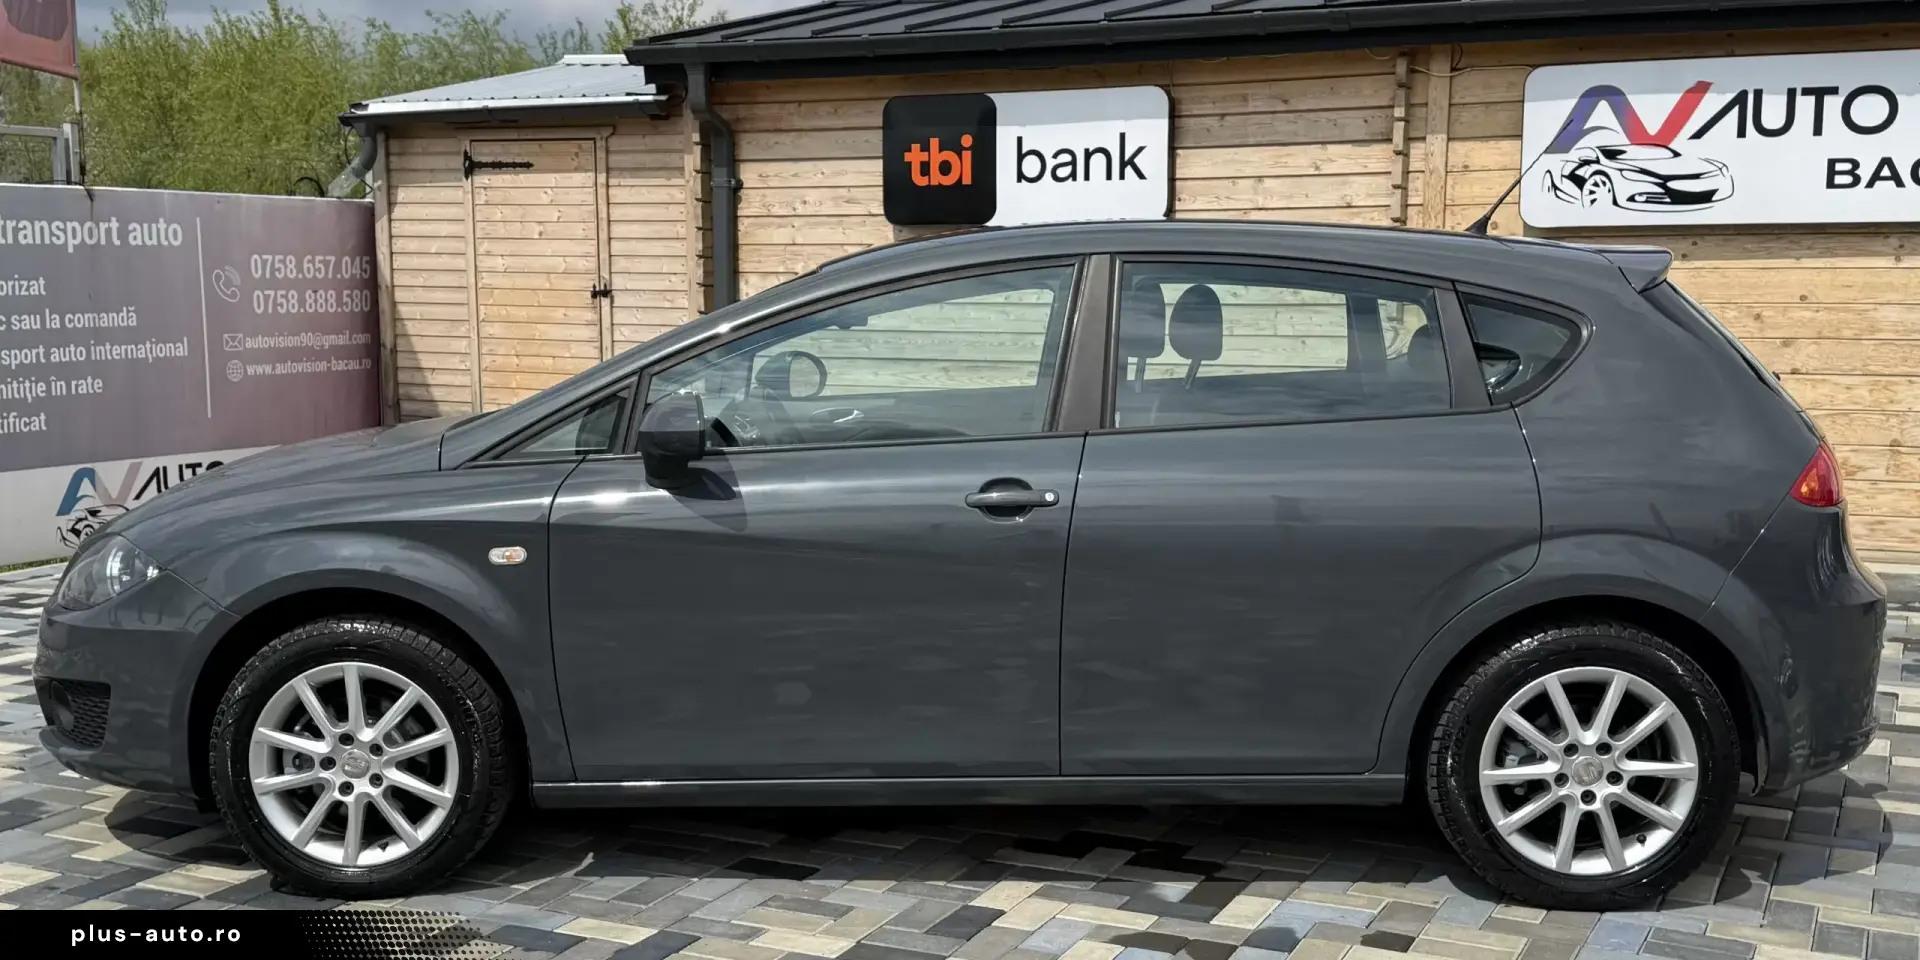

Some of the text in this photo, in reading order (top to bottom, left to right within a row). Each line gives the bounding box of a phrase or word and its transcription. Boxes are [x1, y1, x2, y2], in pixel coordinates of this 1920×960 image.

[1687, 85, 1899, 140] AUTO
[904, 132, 1148, 187] tbi bank
[1826, 156, 1920, 189] BA
[127, 217, 183, 247] auto
[250, 254, 371, 279] 0758.657.045
[253, 290, 371, 314] 0758.888.580
[11, 313, 41, 330] sau
[45, 308, 61, 329] la
[64, 305, 138, 329] comandă
[245, 330, 371, 350] autovision90@gmail.com
[50, 343, 87, 363] auto
[246, 356, 372, 376] www.autovision-bacau.ro
[50, 375, 67, 396] în
[71, 376, 104, 395] rate
